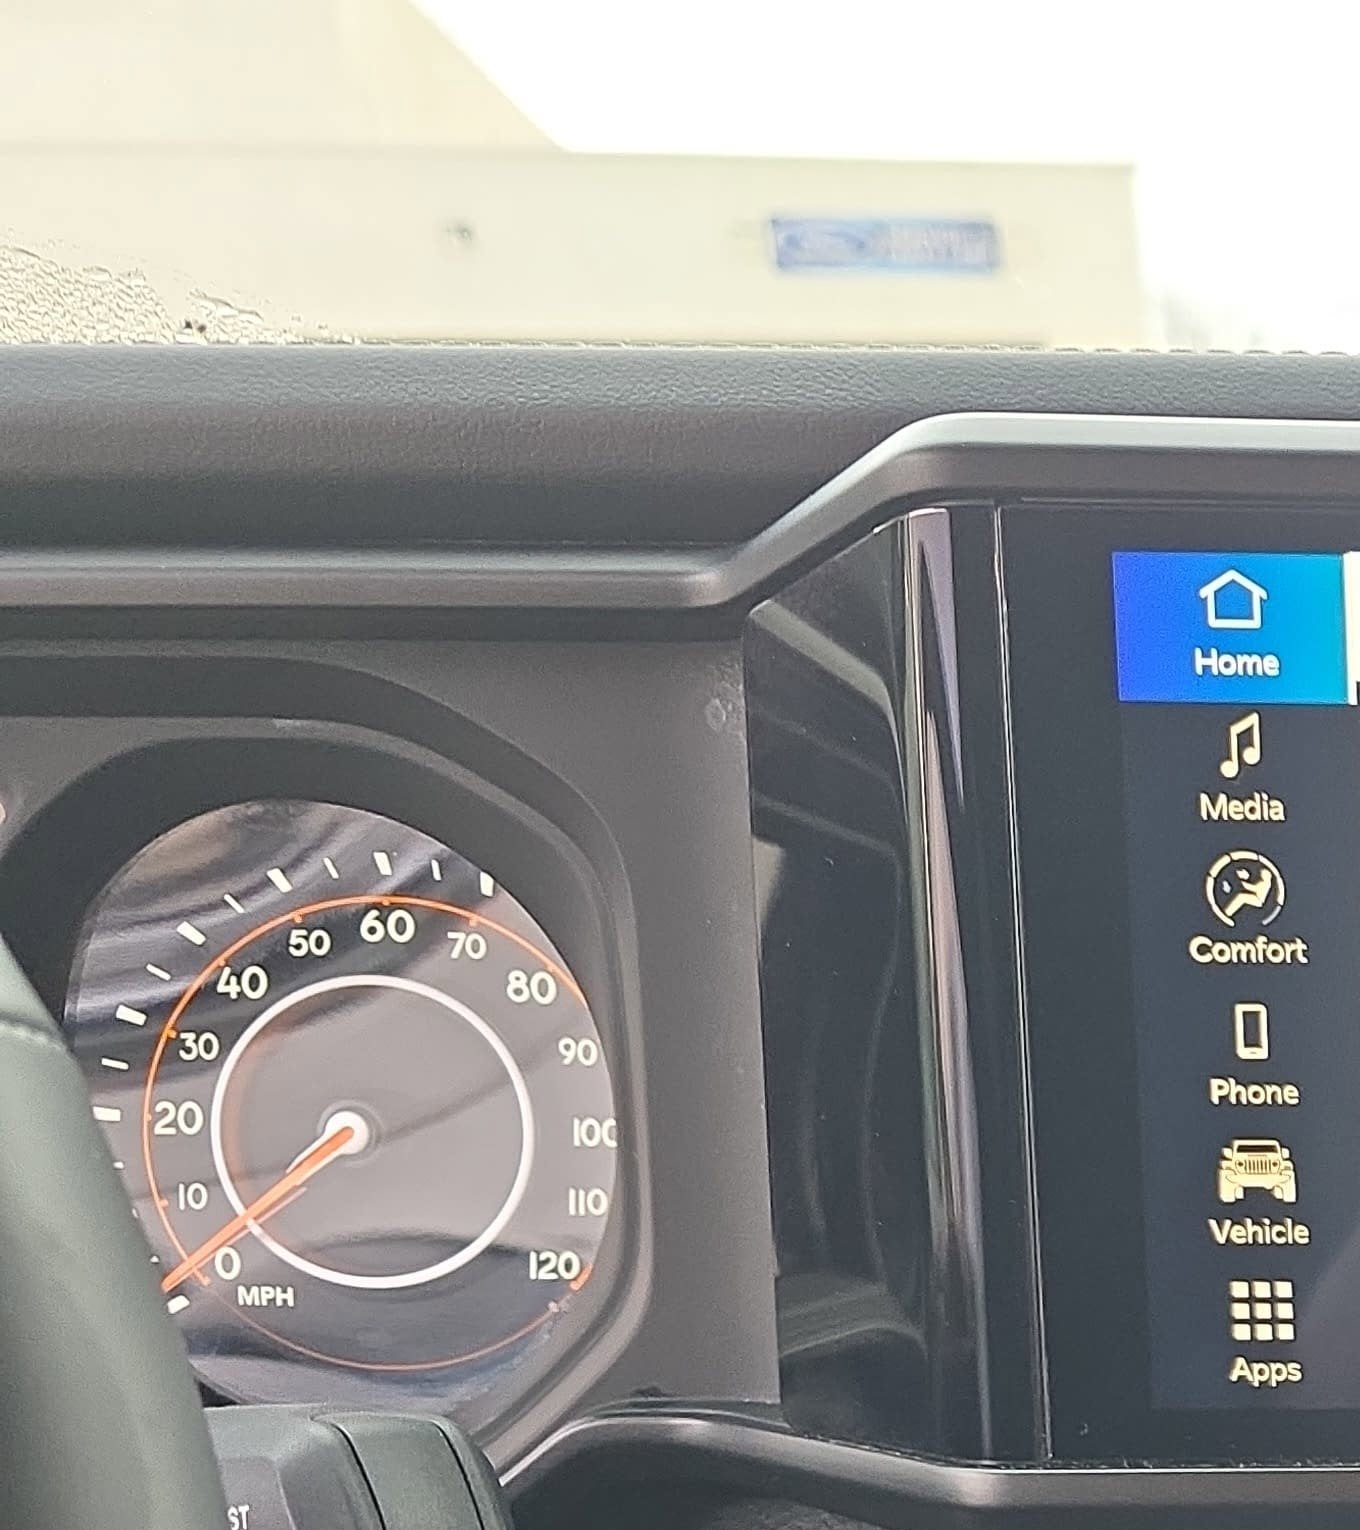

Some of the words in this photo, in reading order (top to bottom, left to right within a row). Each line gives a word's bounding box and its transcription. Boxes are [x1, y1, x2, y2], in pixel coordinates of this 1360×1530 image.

[1195, 647, 1280, 679] Home
[1199, 793, 1286, 822] Media
[359, 909, 416, 944] 60
[288, 929, 331, 957] 50
[447, 932, 487, 960] 70
[1189, 936, 1308, 965] Comfort
[216, 965, 269, 1000] 40
[506, 971, 557, 1005] 80
[178, 1032, 220, 1063] 30
[557, 1038, 598, 1066] 90
[1209, 1078, 1300, 1106] Phone
[153, 1102, 204, 1137] 20
[177, 1183, 208, 1210] 10
[567, 1189, 609, 1216] 110
[1208, 1220, 1310, 1246] Vehicle
[214, 1251, 241, 1281] 0
[528, 1250, 581, 1280] 120
[237, 1285, 295, 1309] MPH
[1229, 1357, 1303, 1386] Apps
